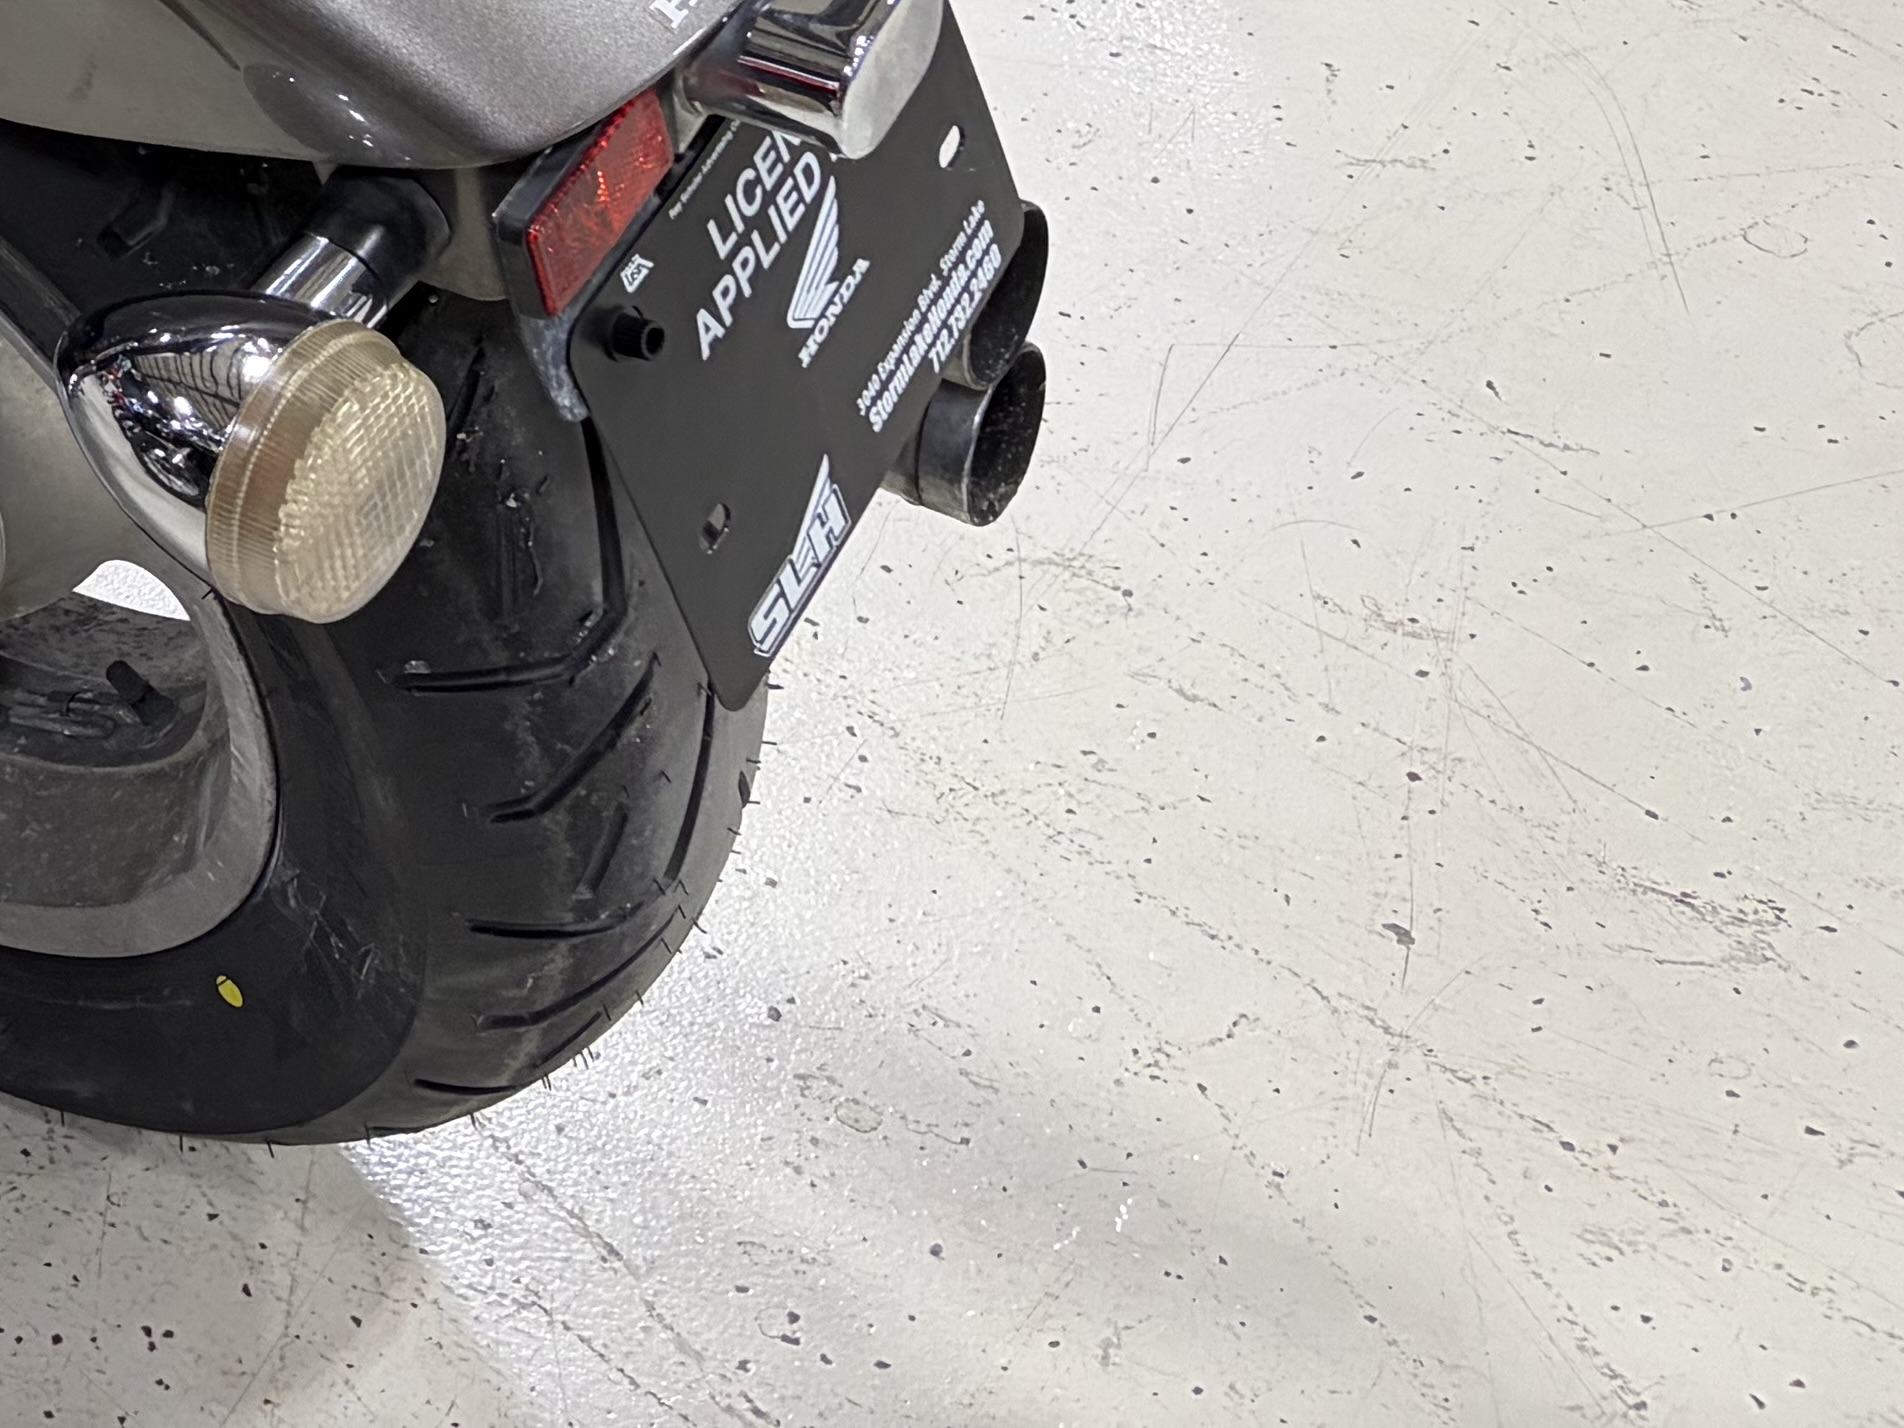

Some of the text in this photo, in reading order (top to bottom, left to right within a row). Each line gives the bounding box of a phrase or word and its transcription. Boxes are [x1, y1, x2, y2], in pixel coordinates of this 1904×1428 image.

[696, 151, 822, 360] APPLIED
[707, 130, 801, 260] LICEN
[798, 258, 870, 368] HONDA
[868, 219, 994, 433] StormLakeHonda.com
[877, 308, 921, 382] Expansion
[940, 231, 967, 276] Storm
[962, 199, 985, 235] Lake
[748, 484, 852, 657] SLH
